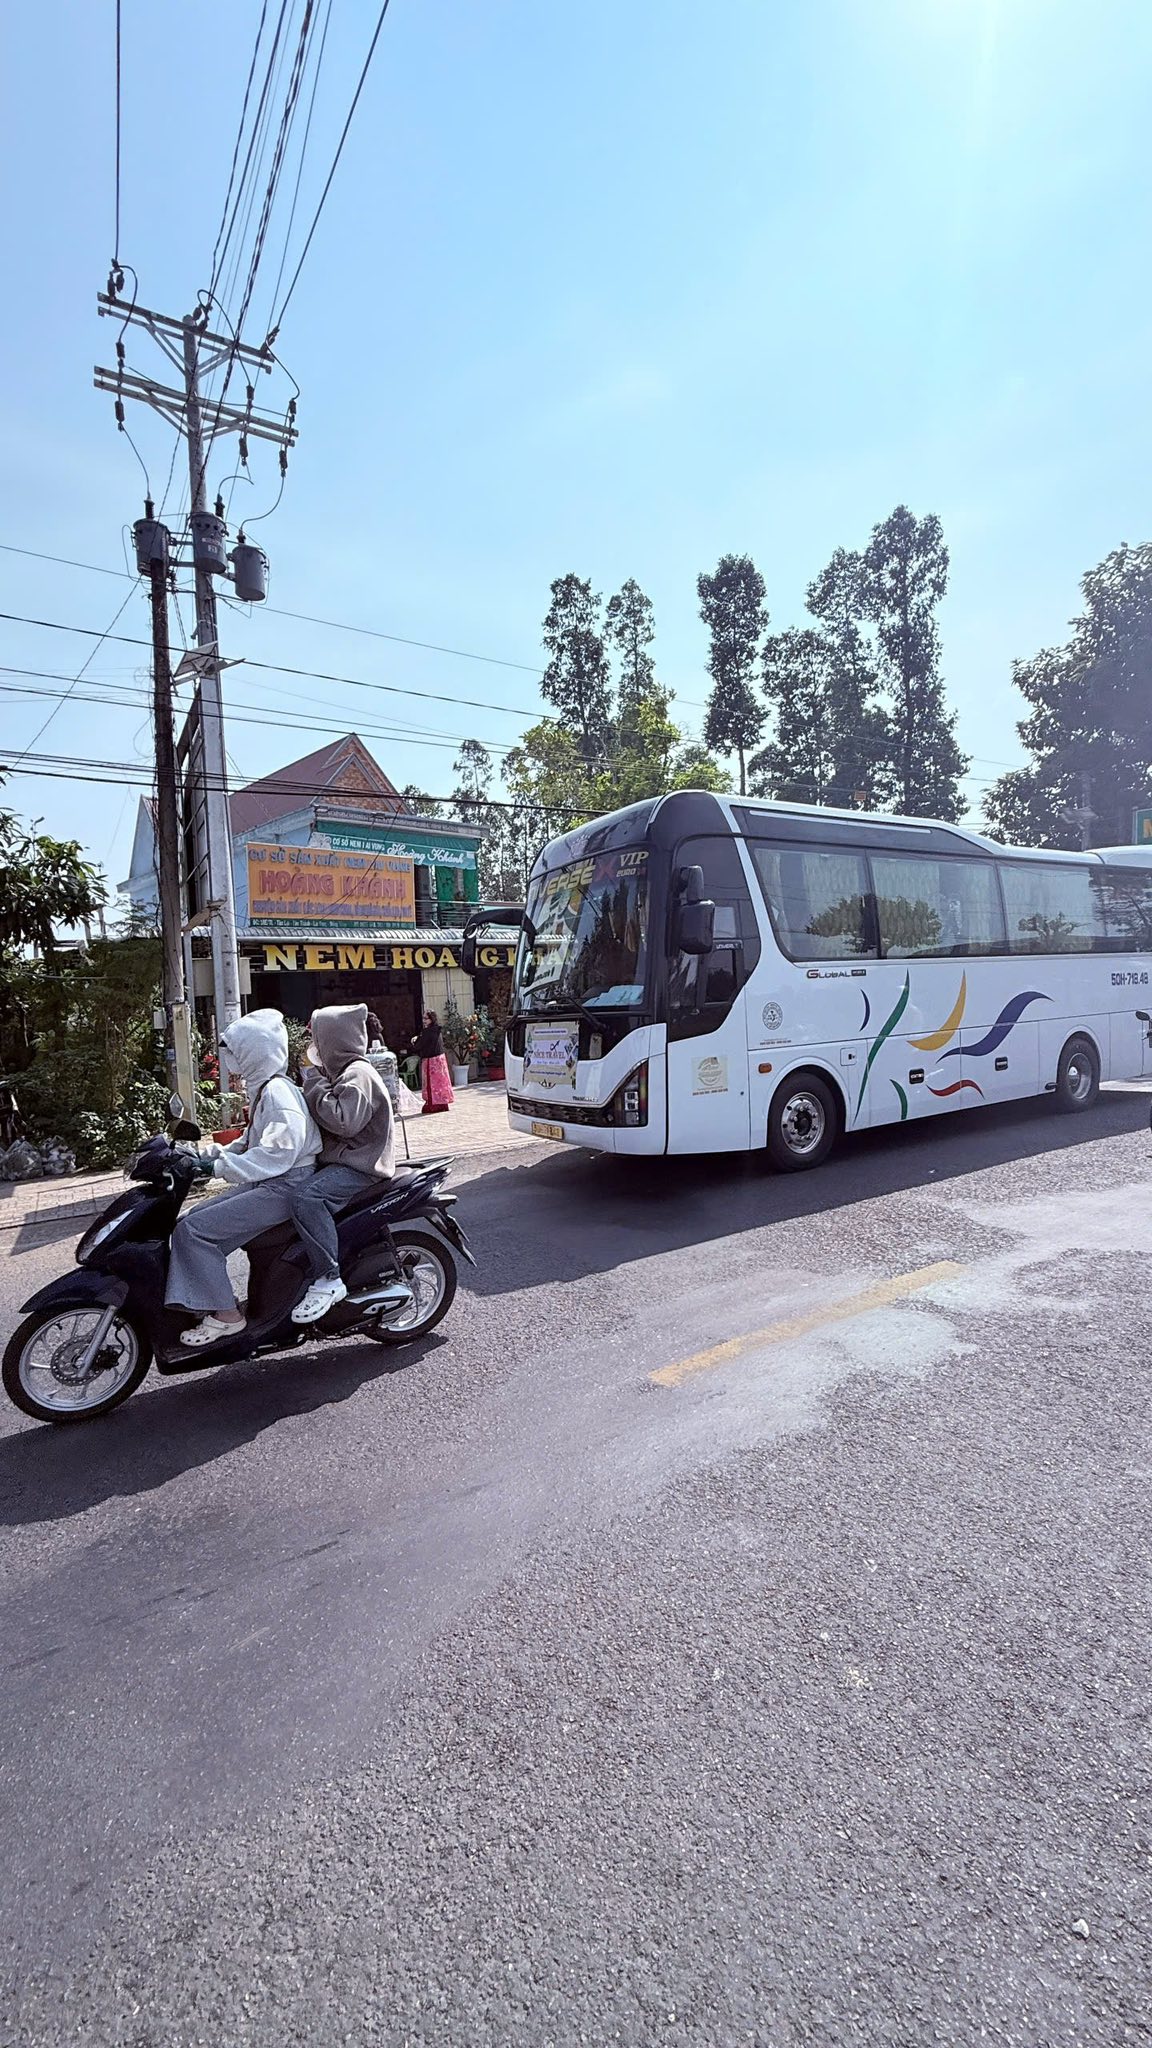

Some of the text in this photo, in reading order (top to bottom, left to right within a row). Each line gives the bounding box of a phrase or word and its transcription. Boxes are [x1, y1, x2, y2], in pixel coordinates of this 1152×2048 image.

[349, 839, 362, 848] NEM
[427, 848, 465, 864] Khánh
[620, 851, 650, 867] VIP
[341, 872, 406, 899] KHÁNH
[262, 944, 376, 971] NEM
[390, 946, 499, 969] HOAG
[806, 969, 850, 979] GLOBAL
[370, 1192, 409, 1214] VISION
